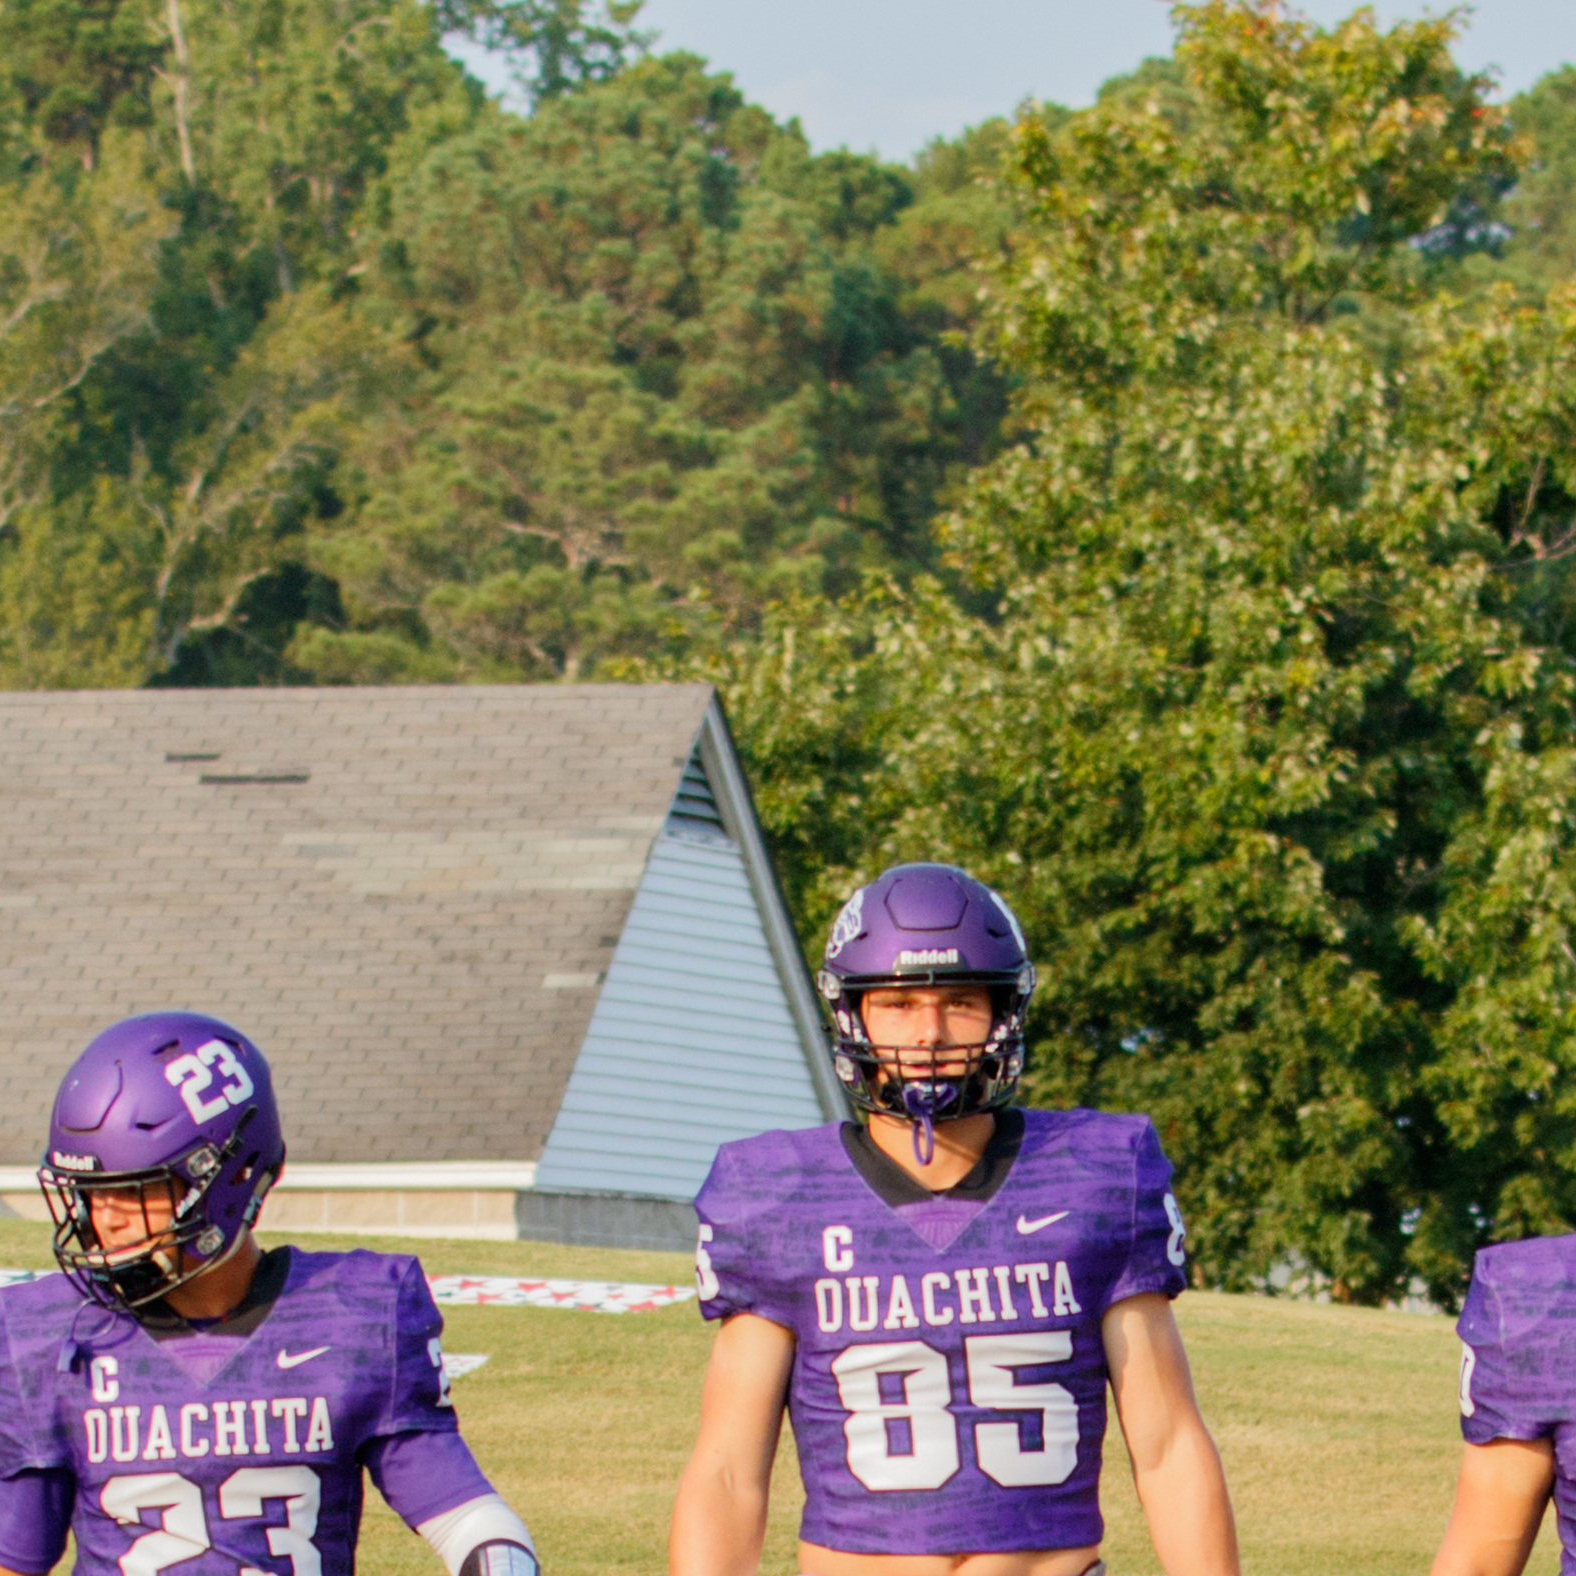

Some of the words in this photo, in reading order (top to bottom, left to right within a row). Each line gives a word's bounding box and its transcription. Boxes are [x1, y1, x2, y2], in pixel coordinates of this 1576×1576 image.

[900, 948, 959, 965] Riddell
[165, 1039, 255, 1125] 23
[822, 1225, 854, 1272] C
[814, 1261, 1081, 1333] OUACHITA
[90, 1355, 119, 1402] C
[830, 1329, 1080, 1491] 85
[83, 1396, 335, 1463] OUACHITA
